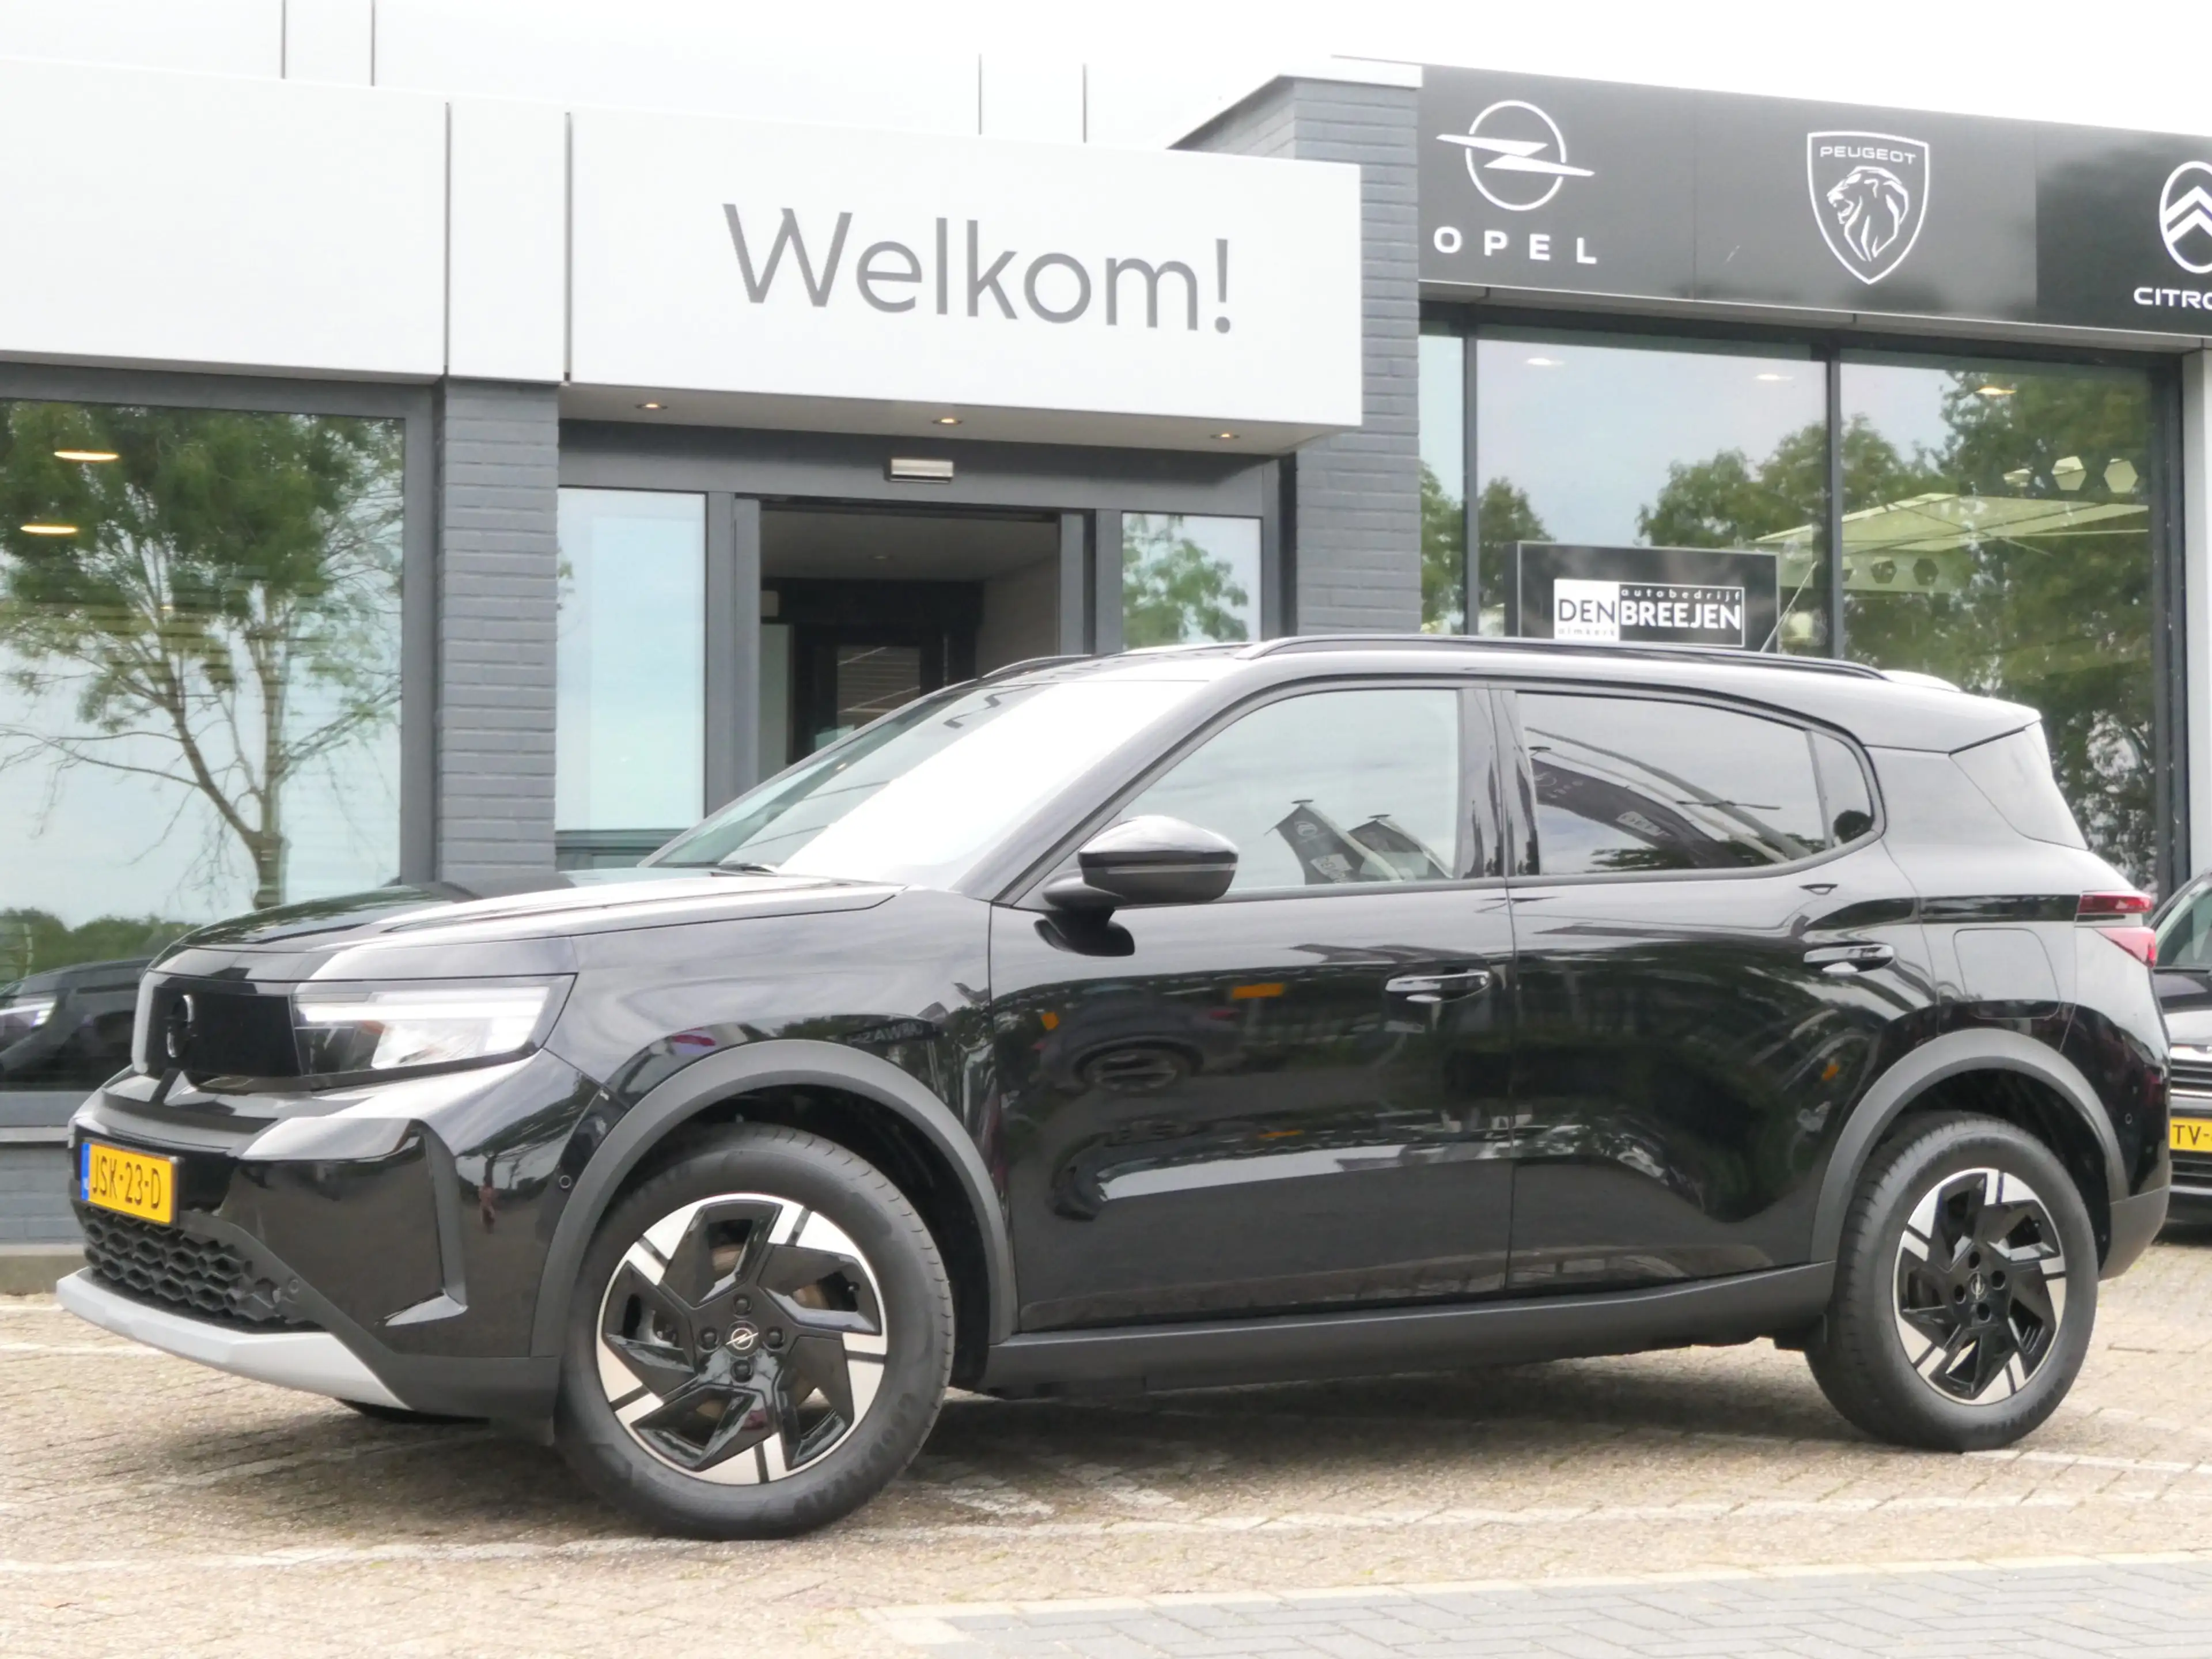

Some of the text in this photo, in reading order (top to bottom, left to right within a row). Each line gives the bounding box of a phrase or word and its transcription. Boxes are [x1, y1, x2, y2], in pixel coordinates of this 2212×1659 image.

[1820, 146, 1917, 165] PEUGEOT
[1434, 226, 1597, 264] OPEL
[722, 203, 1232, 334] Welkom!
[1559, 599, 1741, 630] DEN BREEJEN
[2172, 1124, 2212, 1146] TV-
[92, 1154, 161, 1210] JSK-23-D
